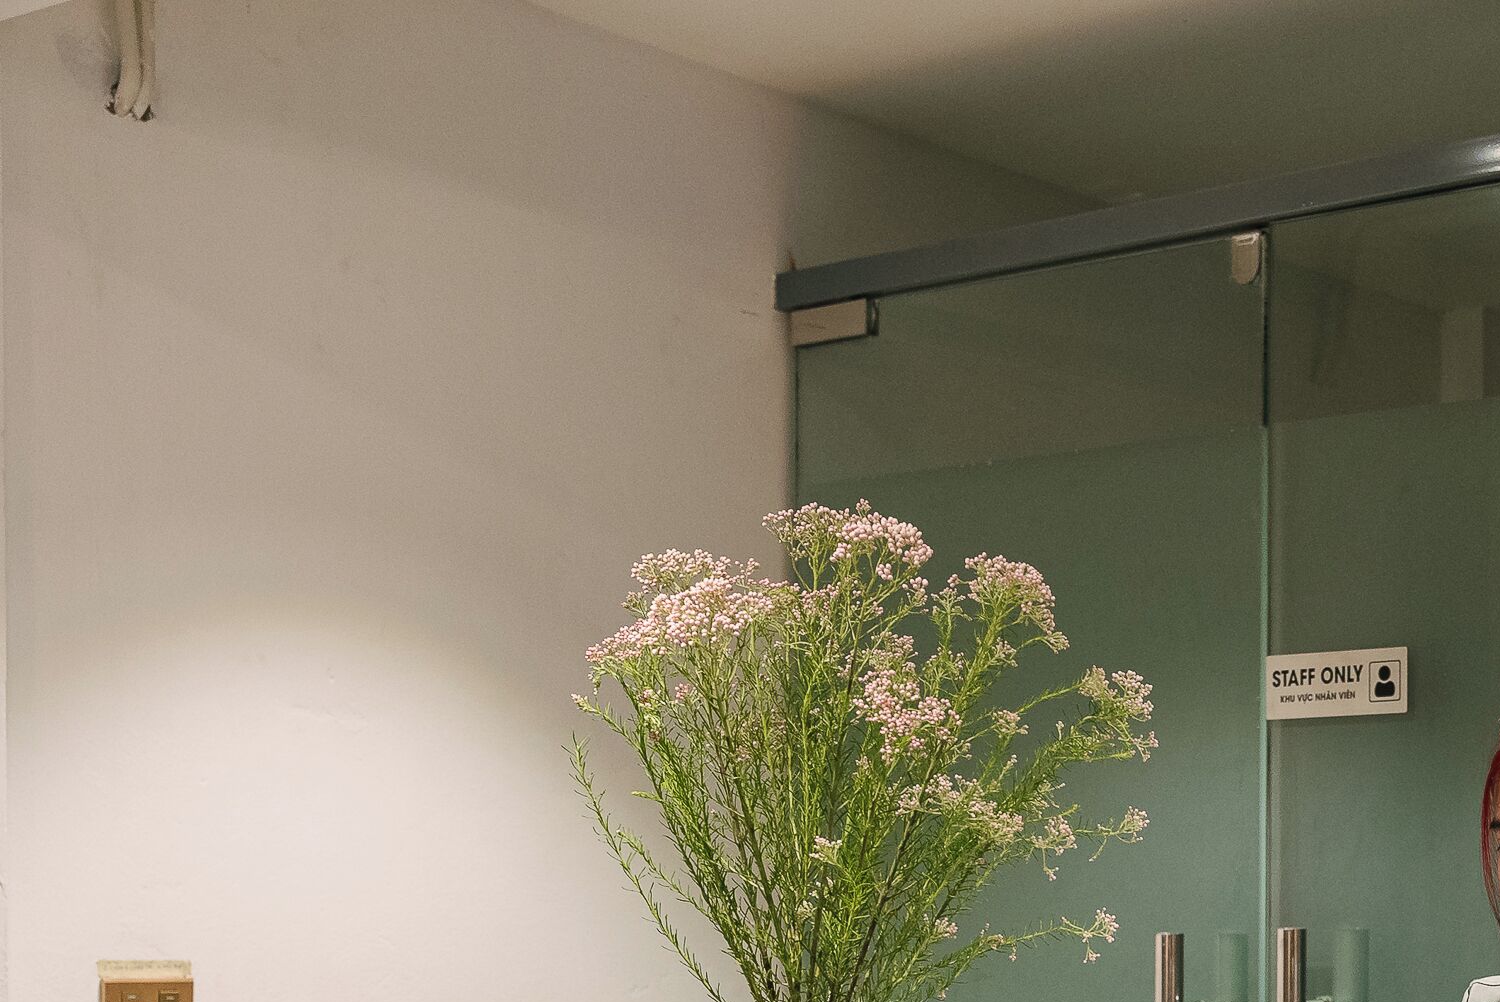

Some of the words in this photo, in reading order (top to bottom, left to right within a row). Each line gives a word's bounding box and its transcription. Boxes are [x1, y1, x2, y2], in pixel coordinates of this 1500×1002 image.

[1272, 667, 1316, 688] STAFF
[1320, 664, 1364, 685] ONLY
[1280, 694, 1296, 704] KHU
[1297, 692, 1313, 705] VỰC
[1315, 690, 1337, 701] NHÂN
[1339, 688, 1356, 700] VIÊN
